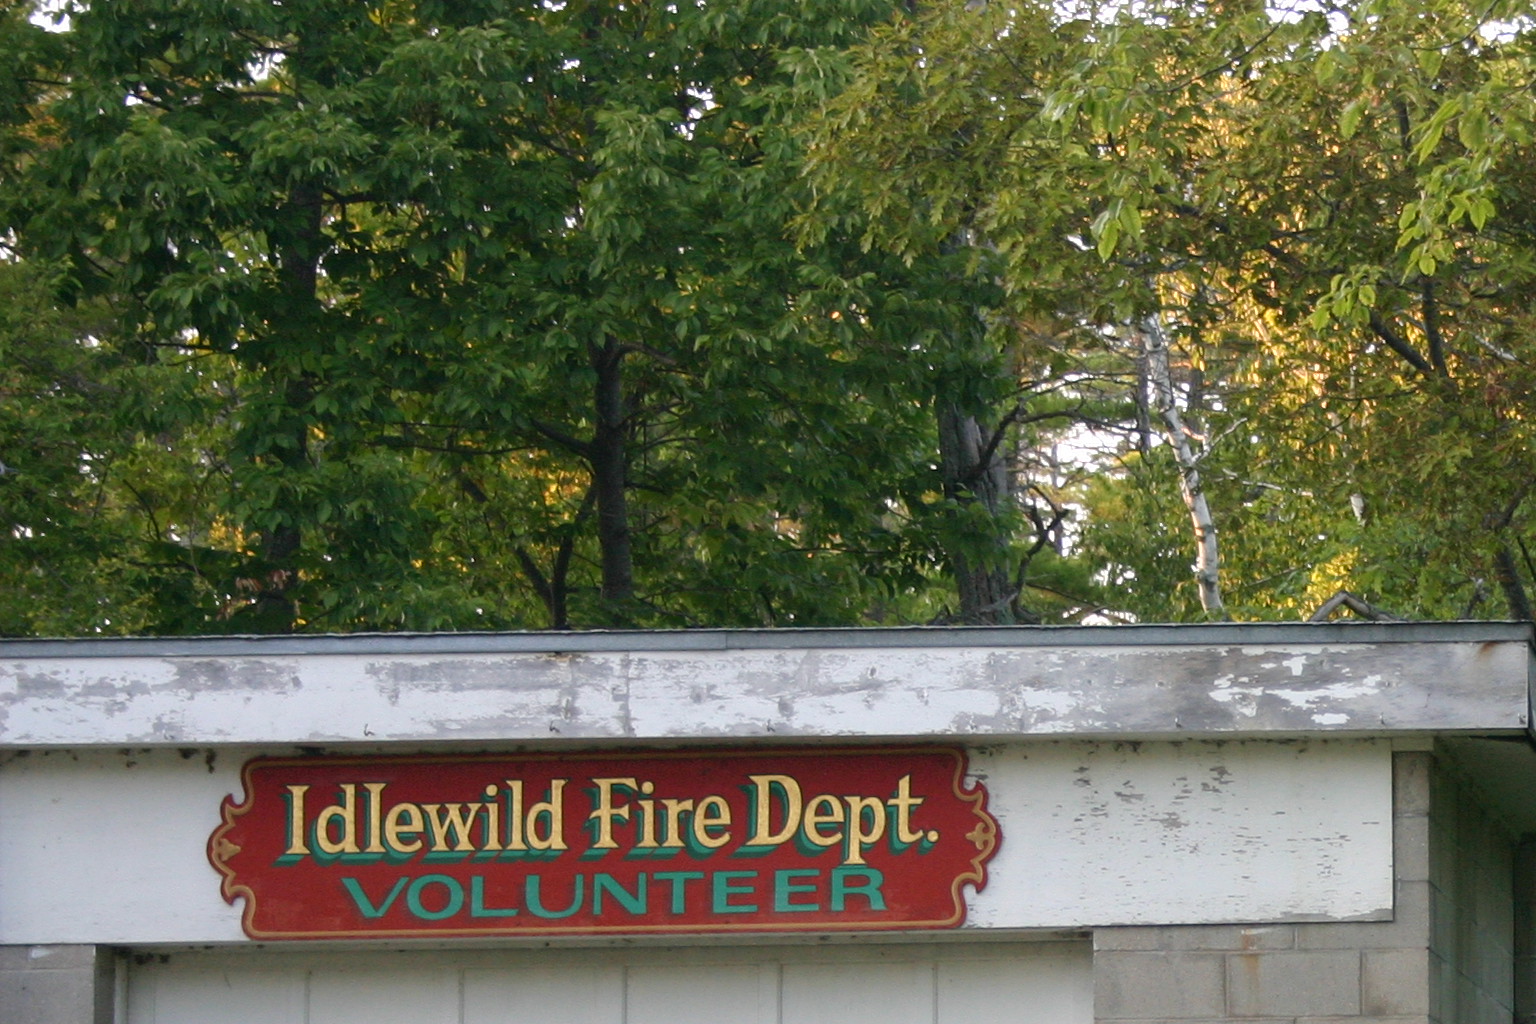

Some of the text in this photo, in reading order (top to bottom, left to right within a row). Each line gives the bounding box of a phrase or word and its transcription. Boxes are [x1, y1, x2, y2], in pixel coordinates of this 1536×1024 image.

[285, 774, 940, 866] Idlewild Fire Dept.
[342, 866, 887, 920] VOLUNTEER
